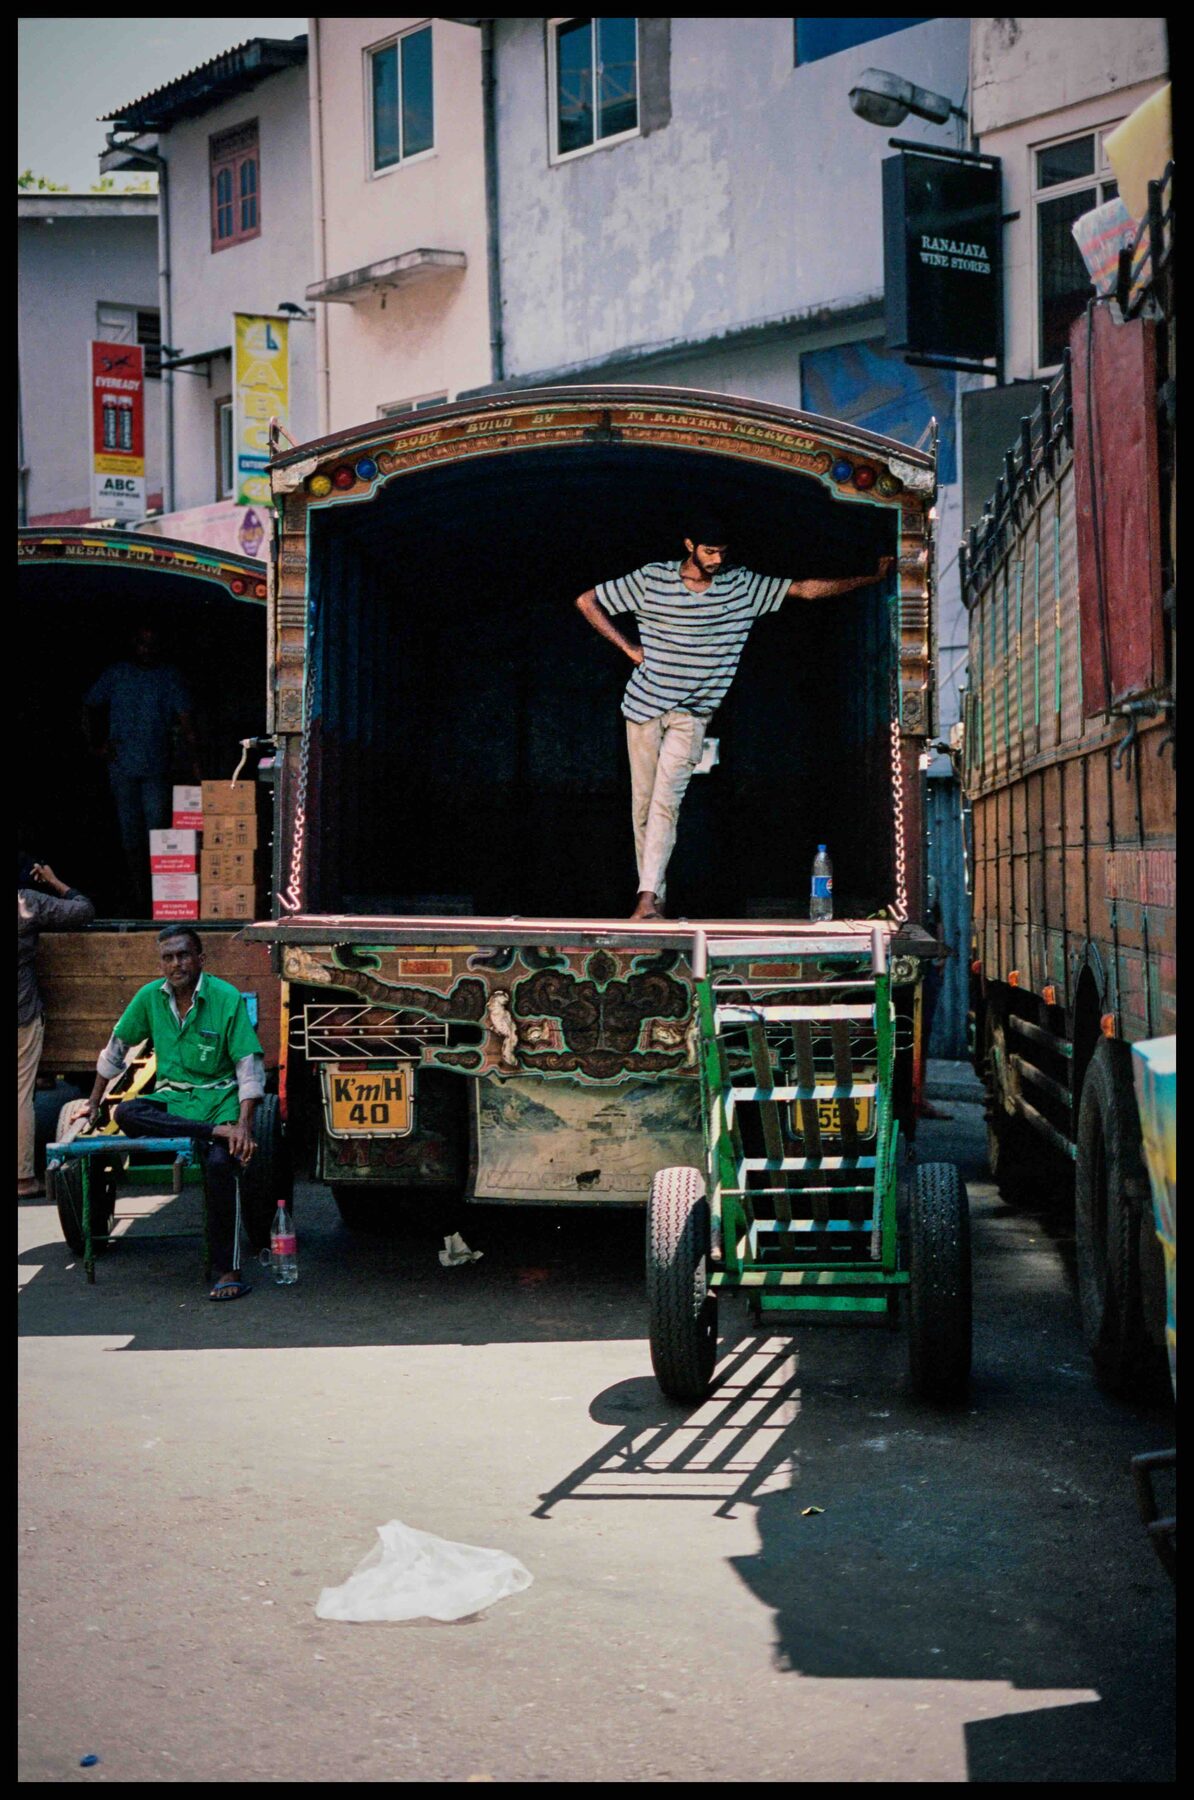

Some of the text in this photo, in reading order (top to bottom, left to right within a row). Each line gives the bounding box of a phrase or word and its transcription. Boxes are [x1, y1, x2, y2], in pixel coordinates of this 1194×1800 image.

[921, 235, 989, 258] RANAJAYA
[919, 252, 990, 274] WINE STORES
[95, 376, 141, 391] EVEREADY
[395, 414, 554, 450] BODY BUILD BY
[104, 477, 136, 492] ABC
[65, 545, 120, 558] NESAN
[349, 1103, 389, 1125] 40
